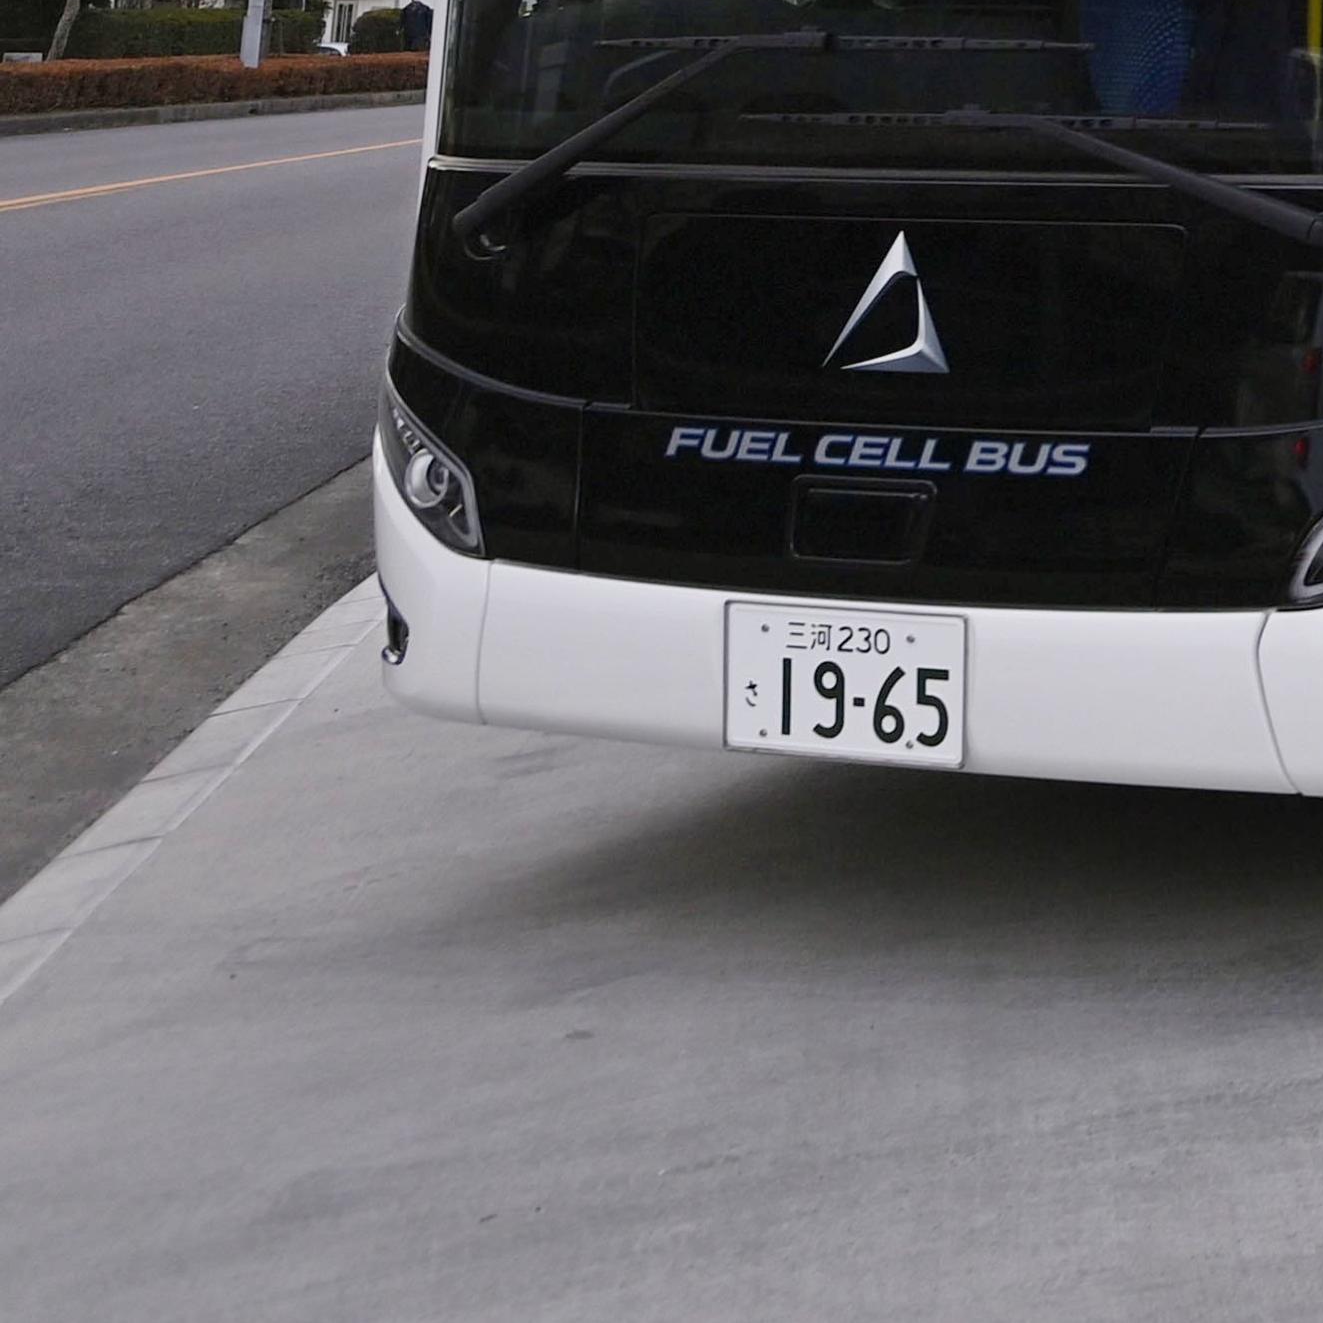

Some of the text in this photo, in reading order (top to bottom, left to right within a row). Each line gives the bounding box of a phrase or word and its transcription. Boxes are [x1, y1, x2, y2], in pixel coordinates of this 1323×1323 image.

[665, 427, 1091, 476] FUEL CELL BUS
[744, 680, 758, 707] さ
[781, 657, 950, 748] 19-65
